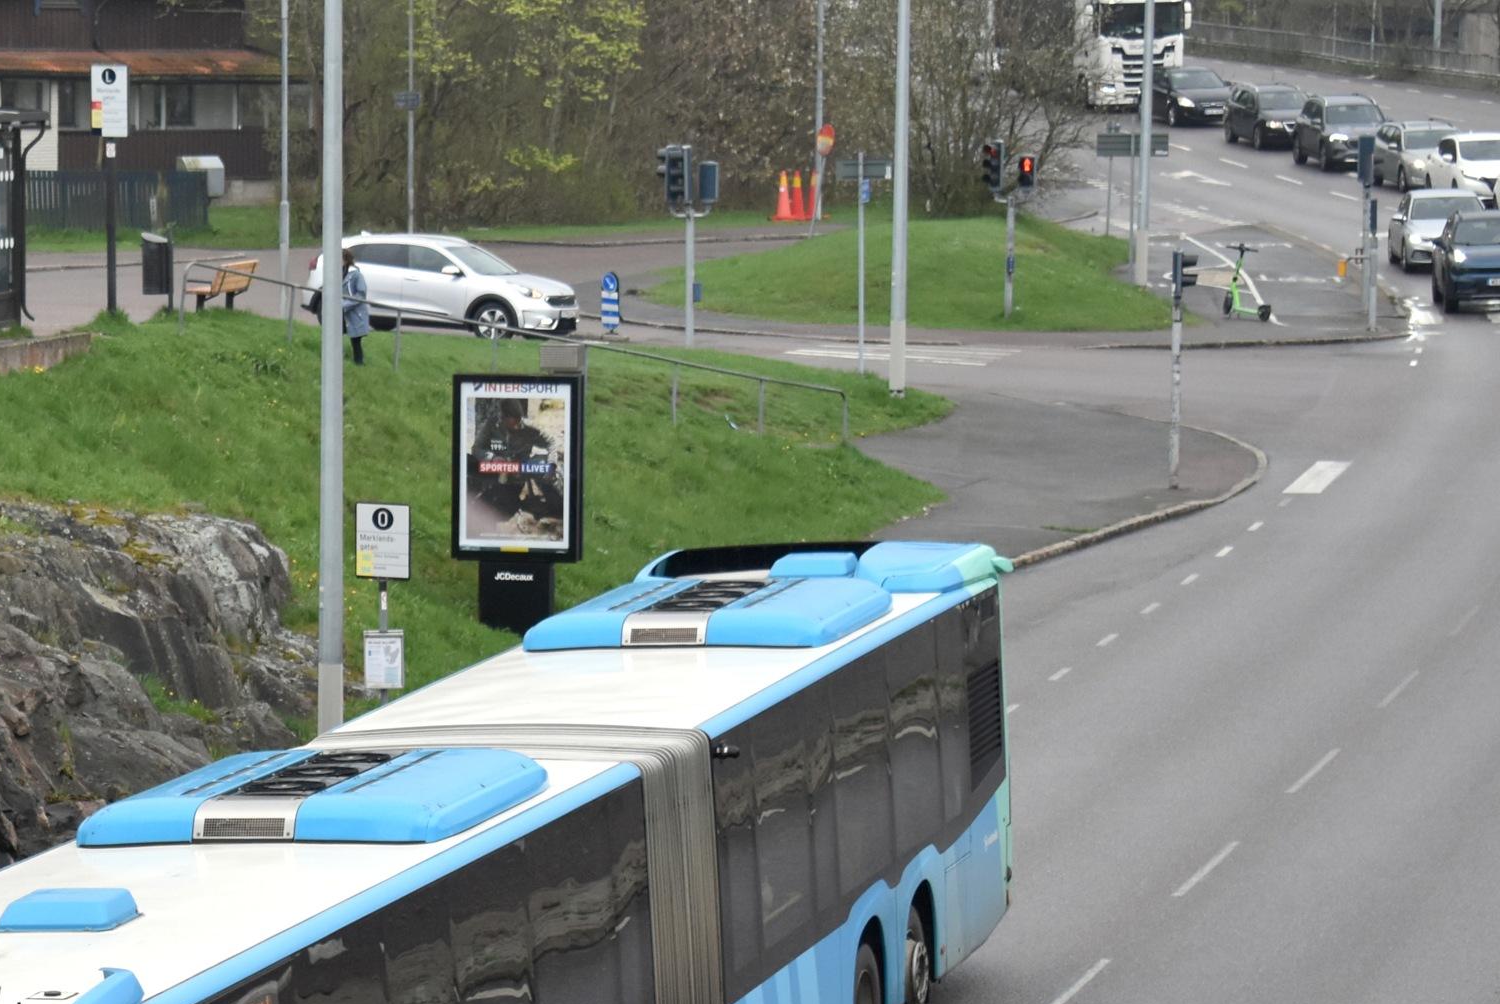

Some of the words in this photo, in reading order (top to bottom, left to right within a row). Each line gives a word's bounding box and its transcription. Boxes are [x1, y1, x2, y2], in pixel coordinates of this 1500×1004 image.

[485, 384, 558, 393] INTERSPORT
[480, 463, 519, 473] SPORTEN
[526, 464, 550, 473] LIVET
[494, 572, 534, 581] JCDecaux
